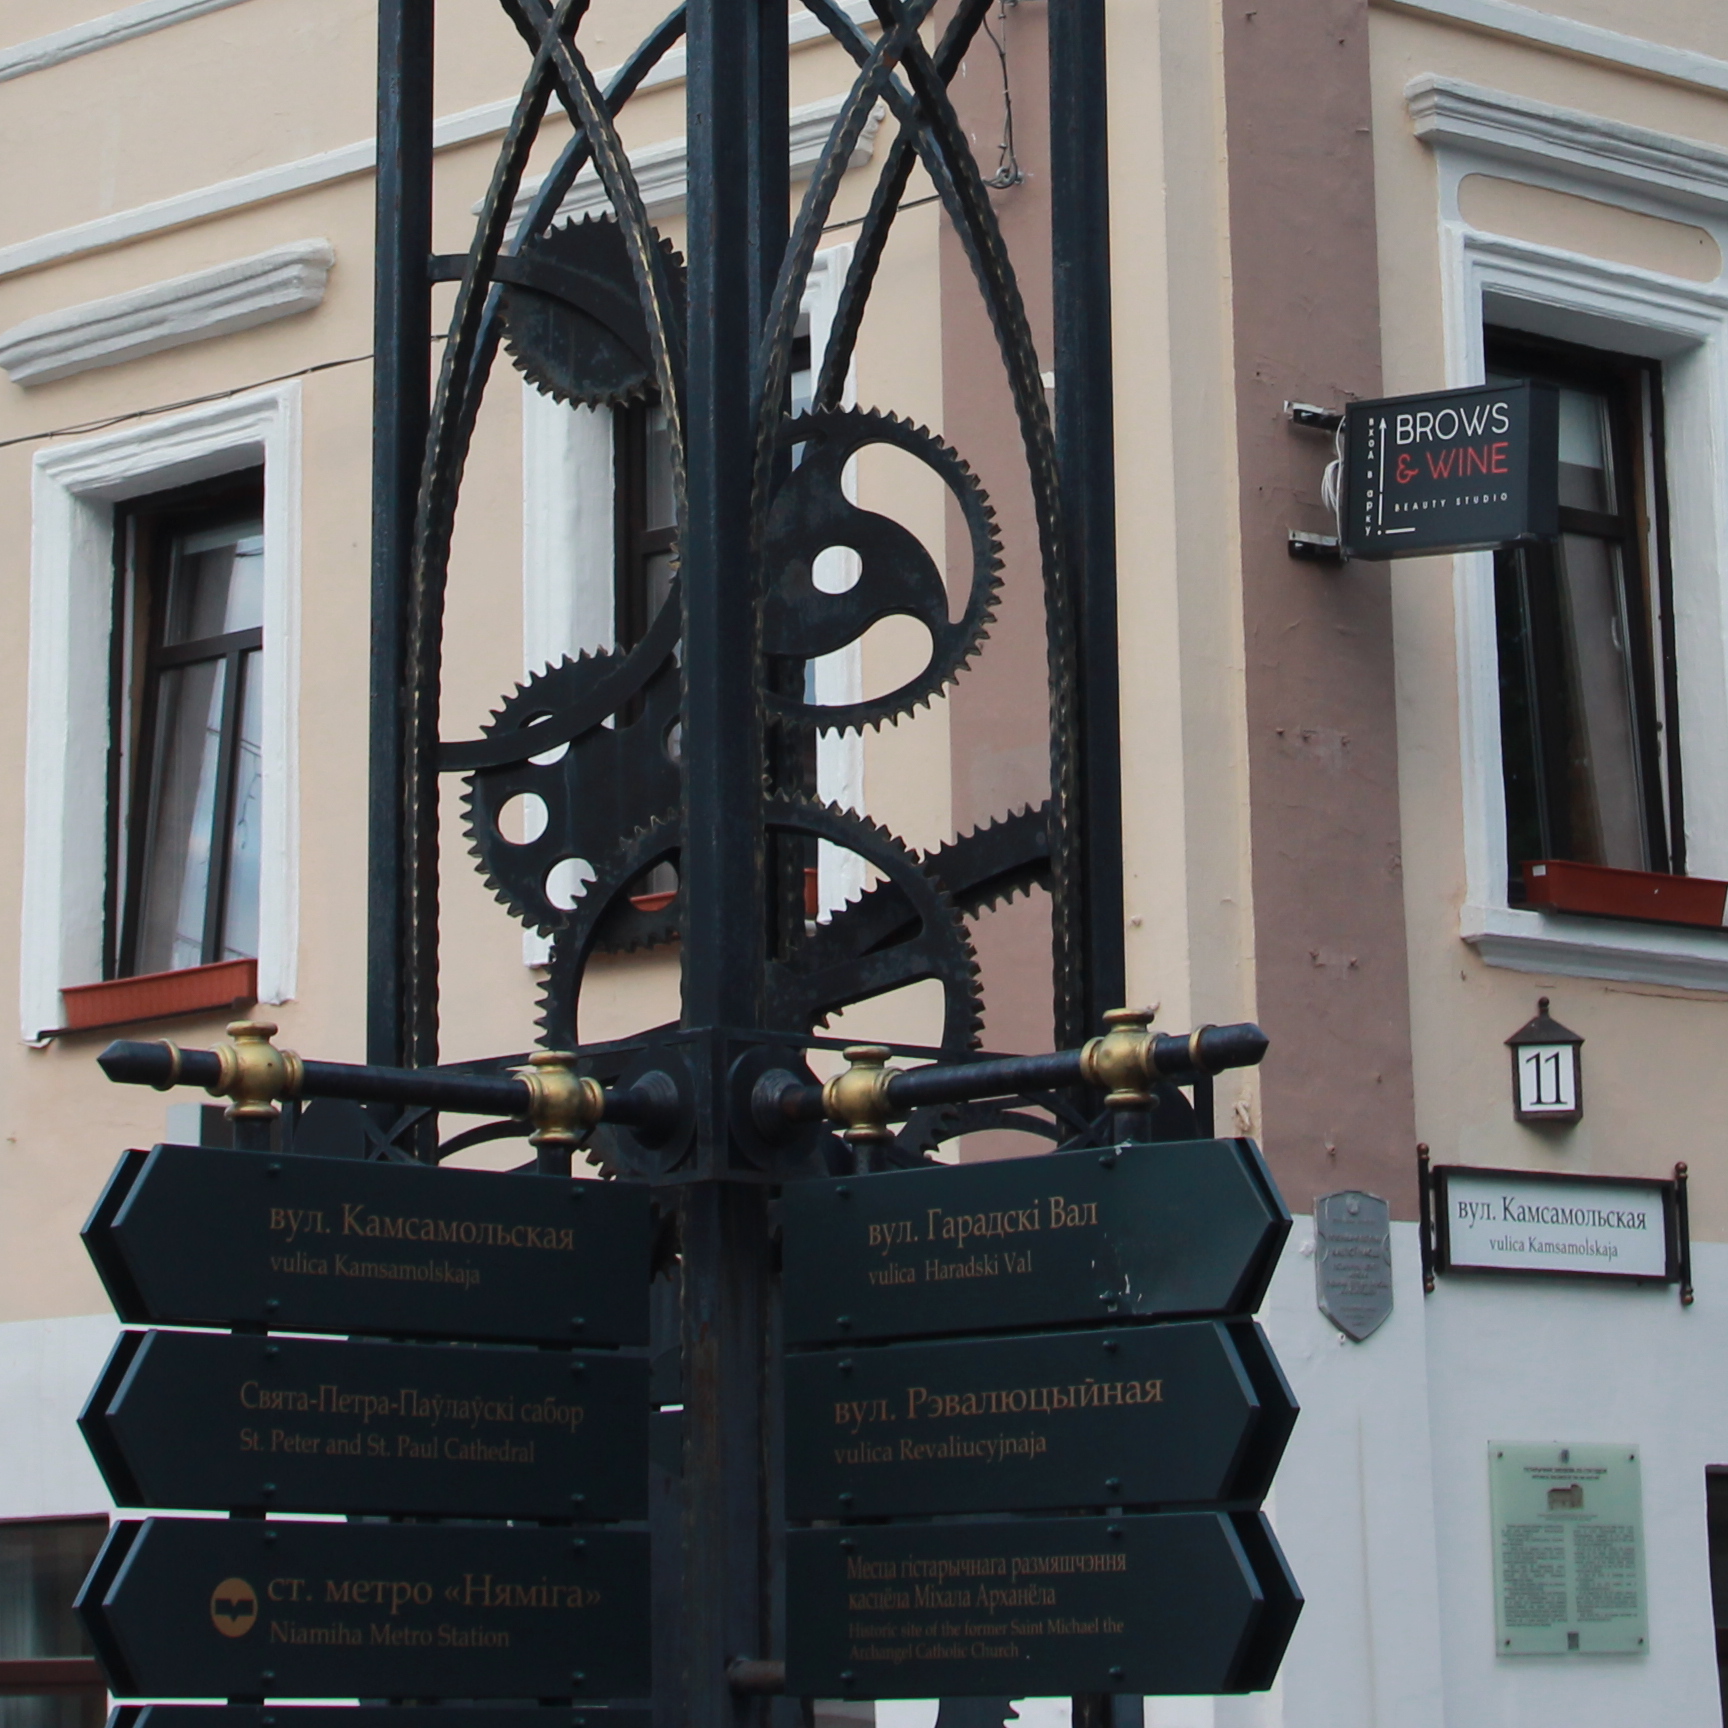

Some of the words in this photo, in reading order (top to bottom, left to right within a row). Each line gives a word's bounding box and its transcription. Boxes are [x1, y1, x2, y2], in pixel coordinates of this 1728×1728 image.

[1396, 402, 1510, 445] BROWS
[1396, 453, 1419, 484] &
[1426, 441, 1510, 480] WINE
[1394, 498, 1447, 512] BEAUTY
[1455, 492, 1509, 506] STUDIO
[1525, 1051, 1568, 1106] 11
[269, 1206, 332, 1243] вул.
[341, 1202, 576, 1251] Камсамольская
[868, 1220, 919, 1257] вул.
[927, 1198, 1041, 1249] Гарадскі
[1048, 1195, 1099, 1229] Вал
[1457, 1199, 1497, 1229] вул.
[1501, 1195, 1647, 1230] Камсамольская
[1489, 1235, 1525, 1253] vulica
[1528, 1236, 1619, 1262] Kamsamolskaja
[269, 1251, 329, 1276] vulica
[334, 1253, 481, 1291] Kamsamolskaja
[868, 1262, 917, 1286] vulica
[924, 1253, 999, 1282] Haradski
[1004, 1249, 1033, 1274] Val
[239, 1379, 515, 1430] Свята-Петра-Паўлаўскі
[520, 1395, 585, 1434] сабор
[833, 1398, 897, 1435] вул.
[905, 1377, 1164, 1420] Рэвалюцыйная
[239, 1427, 264, 1452] St.
[270, 1428, 321, 1454] Peter
[326, 1433, 362, 1456] and
[367, 1434, 391, 1458] St.
[397, 1435, 439, 1460] Paul
[443, 1437, 536, 1464] Cathedral
[834, 1441, 894, 1465] vulica
[900, 1430, 1048, 1463] Revaliucyjnaja
[846, 1555, 897, 1580] Месца
[901, 1553, 1007, 1585] гістарычнага
[1011, 1552, 1127, 1584] размяшчэння
[267, 1577, 313, 1603] ст.
[324, 1579, 433, 1615] метро
[444, 1573, 602, 1609] «Няміга»
[848, 1586, 911, 1611] касцёла
[914, 1583, 971, 1608] Міхала
[975, 1582, 1057, 1615] Арханёла
[269, 1619, 363, 1646] Niamiha
[370, 1622, 433, 1646] Metro
[437, 1623, 511, 1649] Station
[848, 1621, 897, 1639] Historic
[900, 1621, 922, 1638] site
[925, 1620, 939, 1637] of
[940, 1620, 961, 1637] the
[964, 1619, 1008, 1636] former
[1010, 1618, 1044, 1636] Saint
[1047, 1616, 1100, 1635] Michael
[1102, 1615, 1125, 1634] the
[848, 1643, 913, 1665] Archangel
[915, 1642, 968, 1660] Catholic
[970, 1641, 1020, 1659] Church
